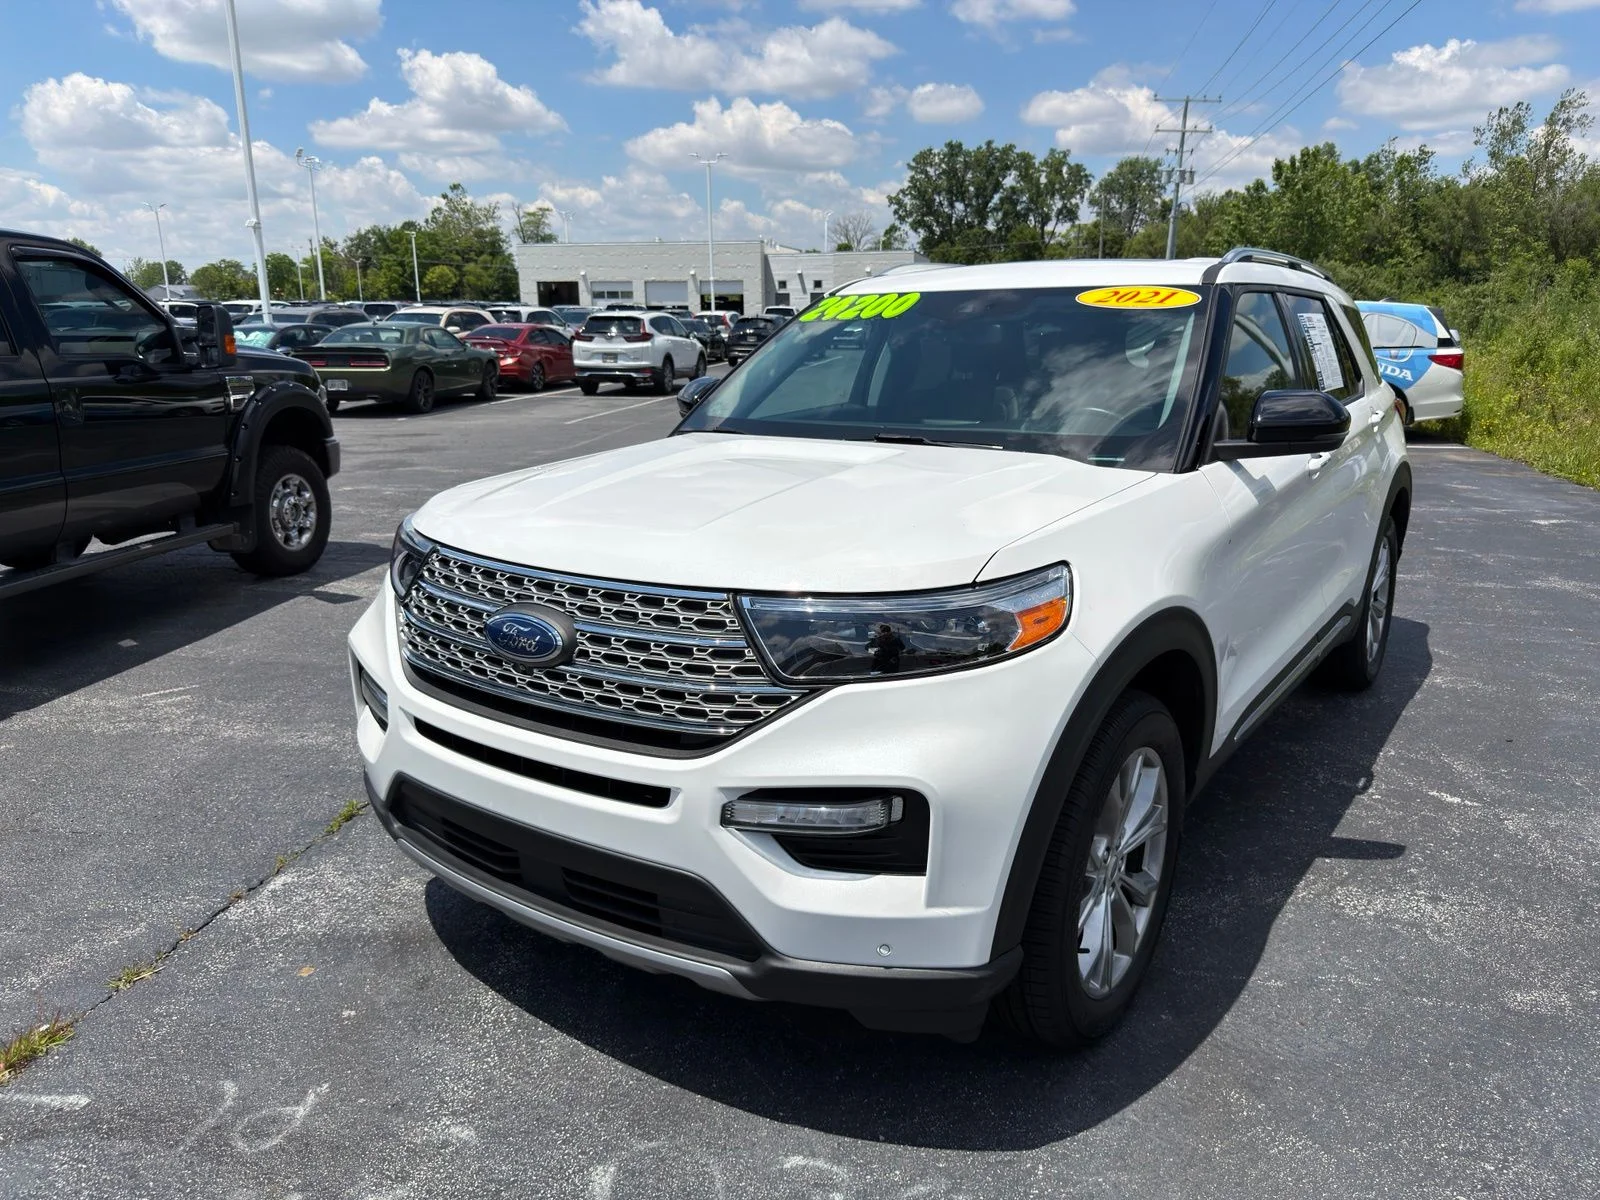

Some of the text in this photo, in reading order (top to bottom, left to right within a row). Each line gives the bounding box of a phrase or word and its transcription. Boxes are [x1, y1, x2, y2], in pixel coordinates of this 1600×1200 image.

[799, 292, 920, 322] 24200
[1093, 290, 1179, 304] 2021
[1377, 362, 1413, 381] NDA
[498, 622, 541, 653] Ford
